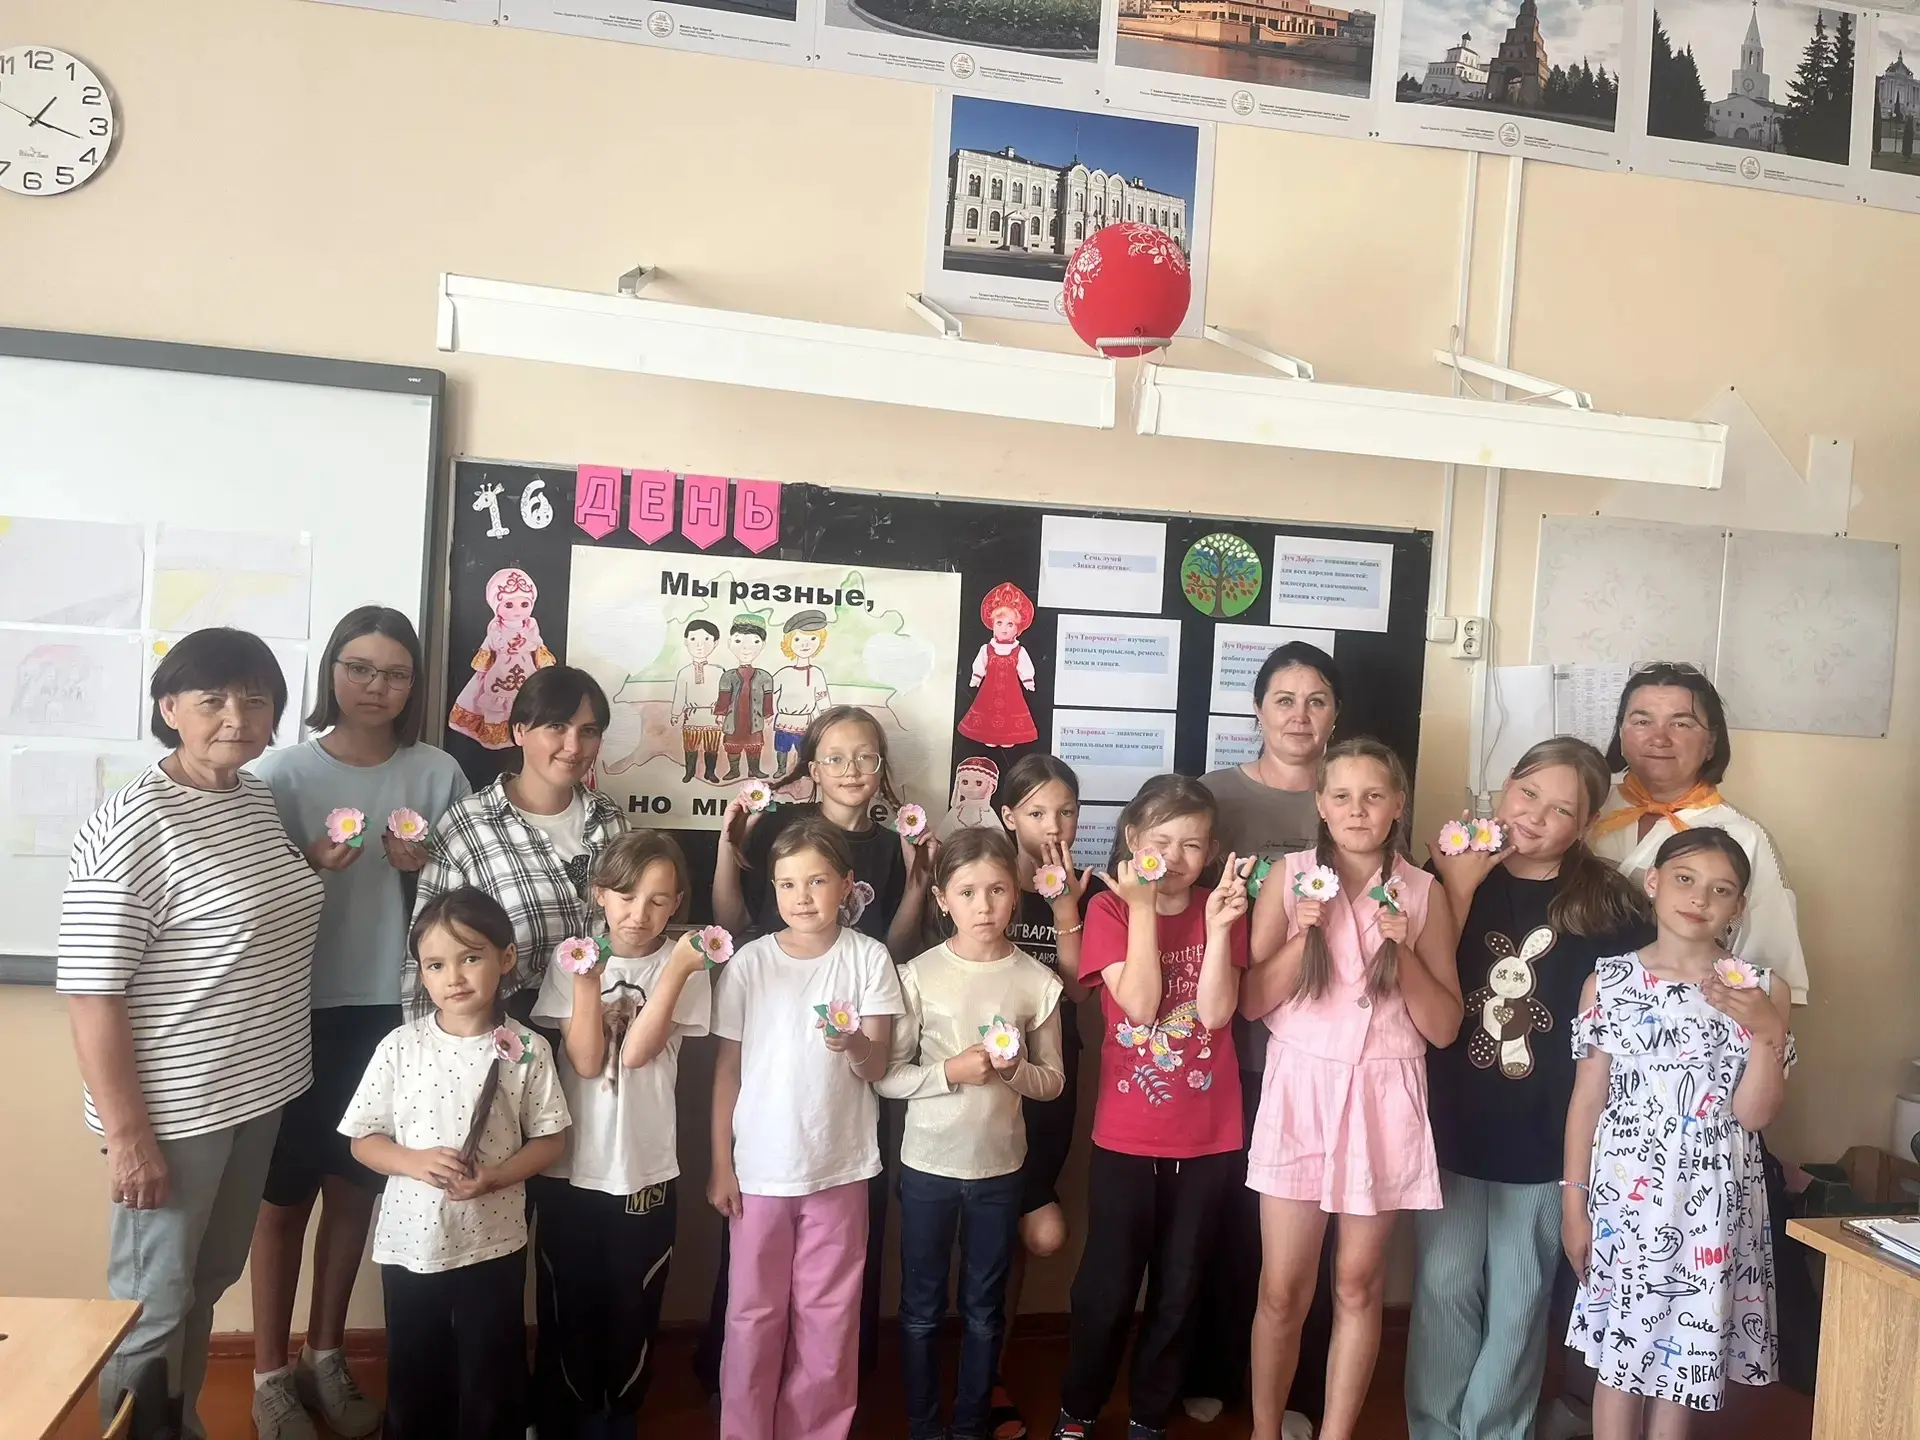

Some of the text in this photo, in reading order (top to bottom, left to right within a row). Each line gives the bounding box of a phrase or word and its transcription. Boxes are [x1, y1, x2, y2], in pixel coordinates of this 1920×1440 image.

[24, 50, 54, 71] 12
[65, 62, 75, 81] 1
[82, 86, 102, 105] 2
[89, 117, 108, 136] 3
[79, 147, 98, 165] 4
[23, 171, 42, 190] 6
[55, 166, 74, 185] 5
[576, 475, 774, 531] ДЕНЬ
[1084, 553, 1122, 564] Семь лучей
[1282, 554, 1295, 562] Луч
[1295, 555, 1315, 564] Добра
[660, 570, 875, 612] Мы разные,
[1065, 633, 1079, 641] Луч
[1080, 634, 1118, 643] Творчества
[1236, 643, 1266, 651] Природы
[1060, 727, 1074, 736] Луч
[1075, 728, 1106, 736] Здоровья
[628, 794, 672, 815] но
[1005, 923, 1057, 941] ОГВАРТ
[1160, 944, 1205, 964] eautif
[1166, 978, 1198, 998] Hap
